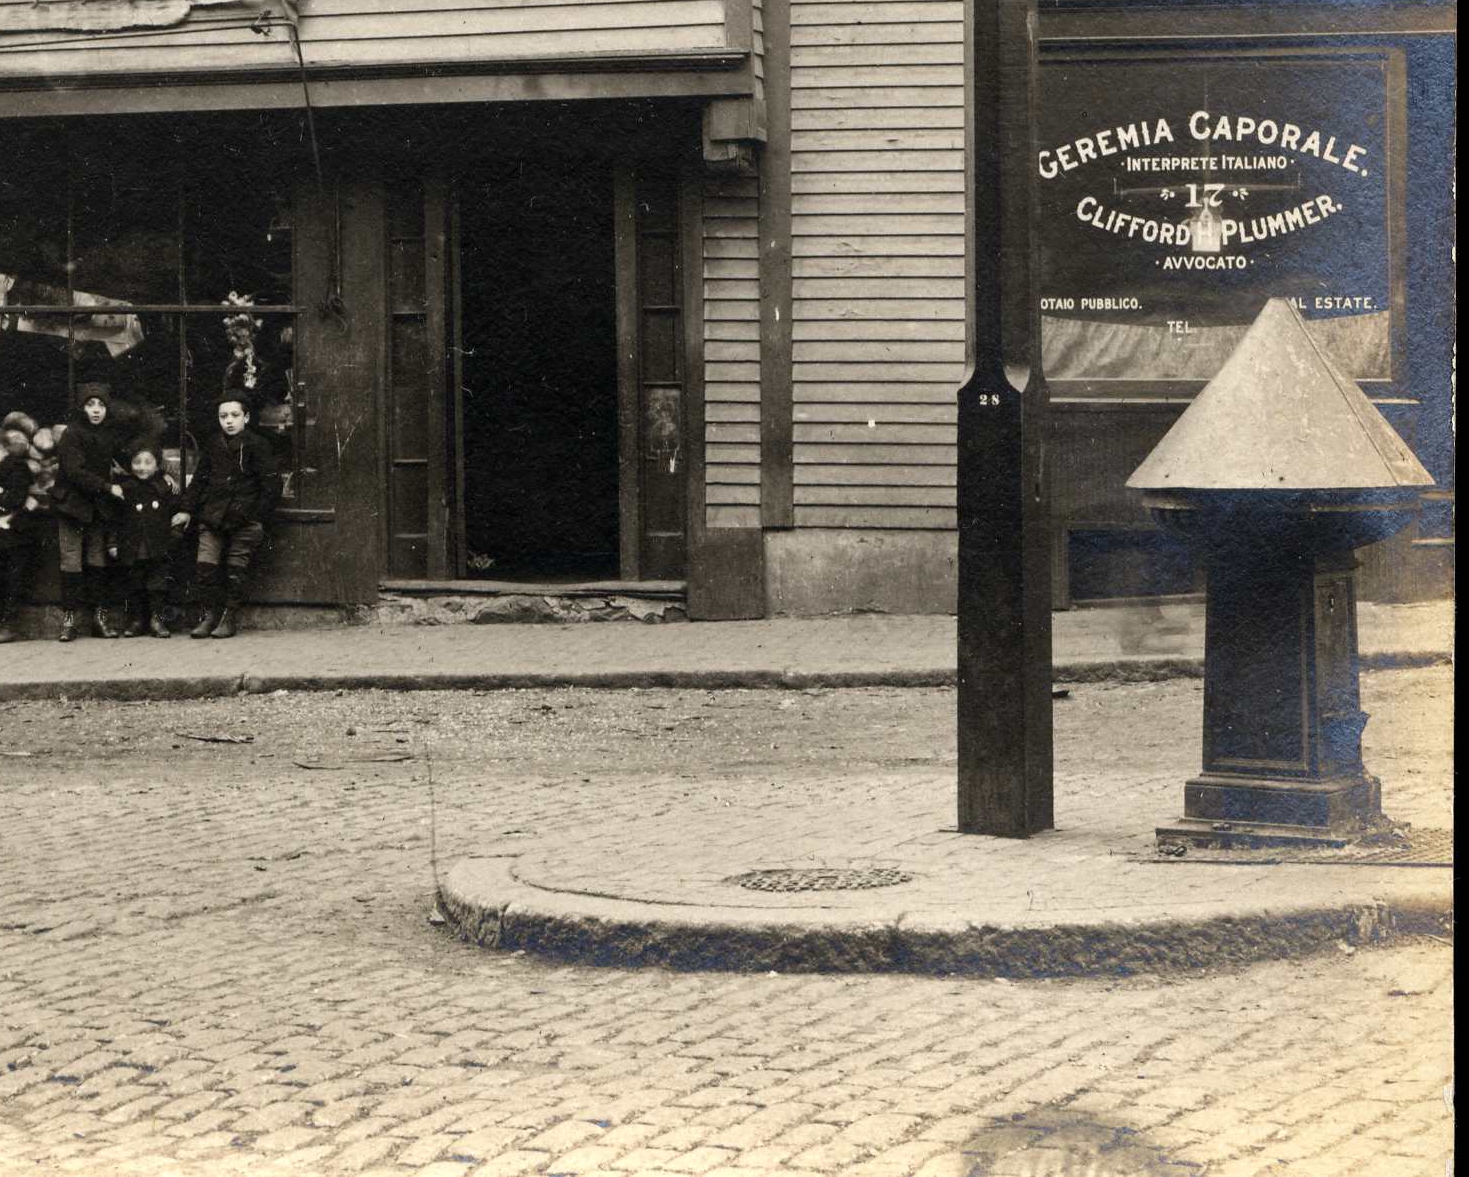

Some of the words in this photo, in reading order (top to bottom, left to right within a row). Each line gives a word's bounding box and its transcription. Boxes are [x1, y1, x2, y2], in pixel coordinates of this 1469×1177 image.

[1039, 118, 1174, 180] GEREMIA
[1188, 110, 1370, 177] CAPORALE.
[1125, 155, 1219, 172] INTERPRETE
[1221, 154, 1288, 171] ITALIANO
[1184, 182, 1226, 208] 17
[1076, 195, 1190, 247] CLIFFORD
[1162, 255, 1248, 271] AVVOCATO
[1081, 298, 1144, 310] PUBBLICO.
[1315, 297, 1378, 310] ESTATE.
